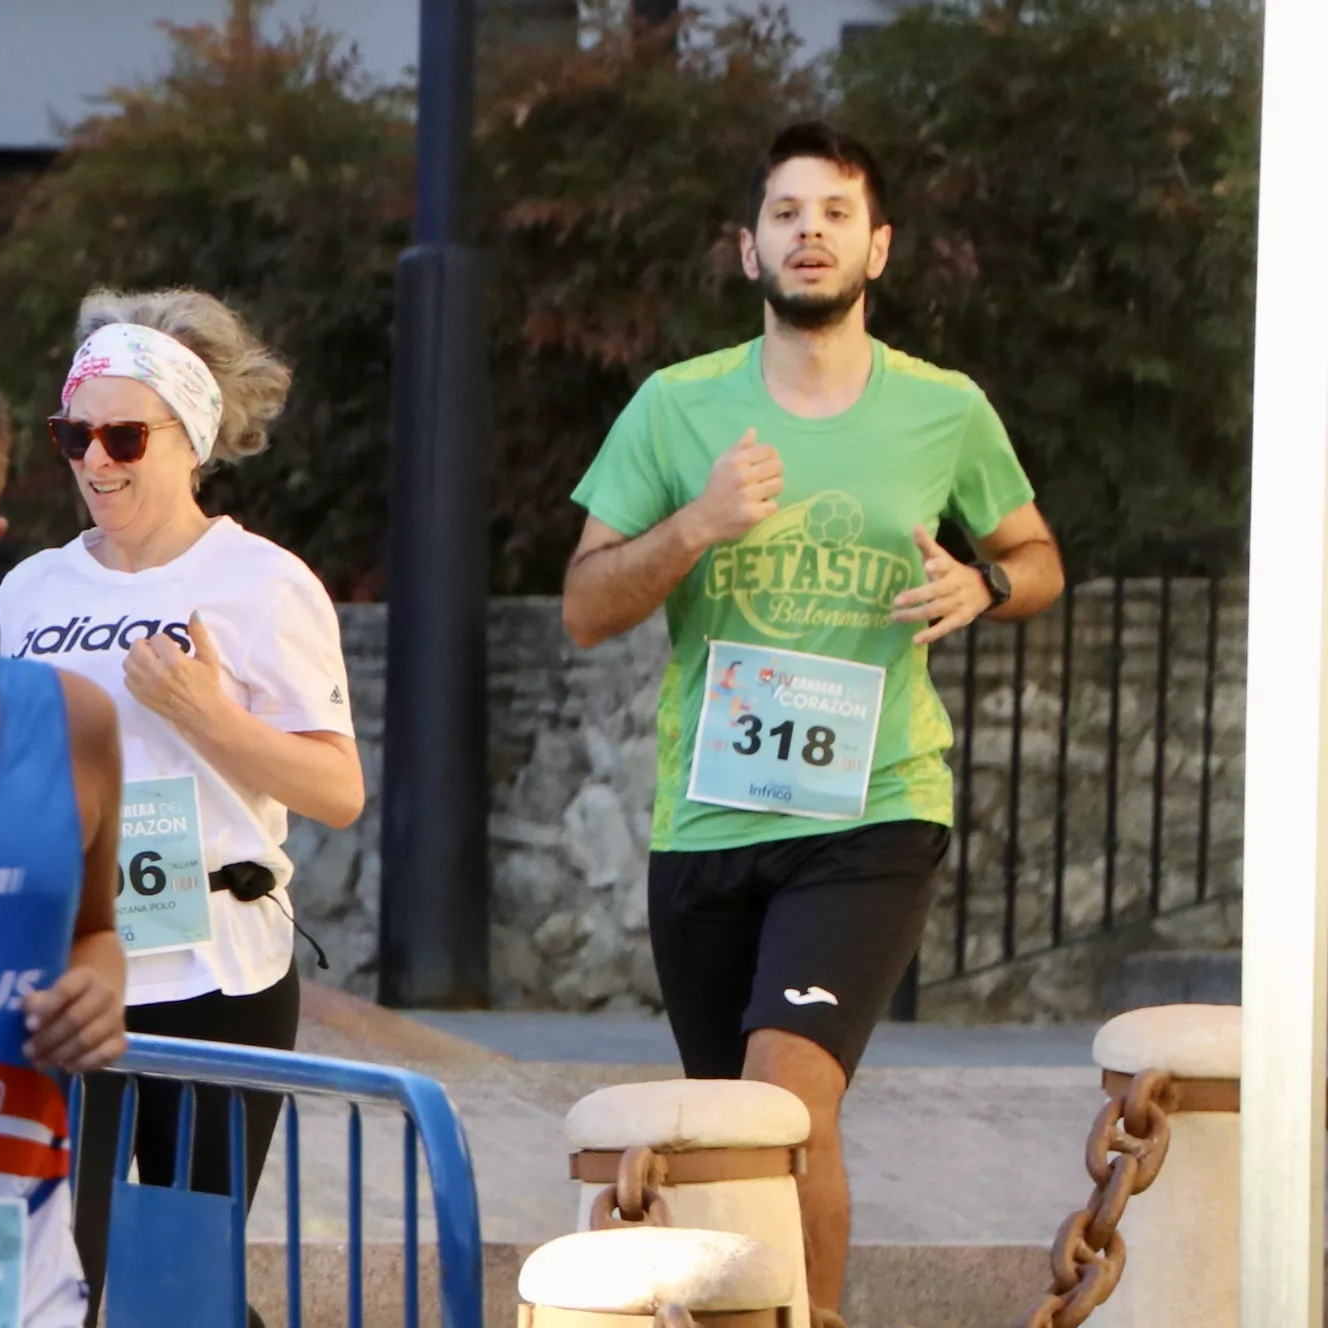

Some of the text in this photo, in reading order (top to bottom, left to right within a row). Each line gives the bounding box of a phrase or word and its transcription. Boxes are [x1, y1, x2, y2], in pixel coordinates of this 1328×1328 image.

[732, 713, 836, 767] 318
[122, 817, 187, 838] RAZON
[116, 904, 147, 915] NTANA
